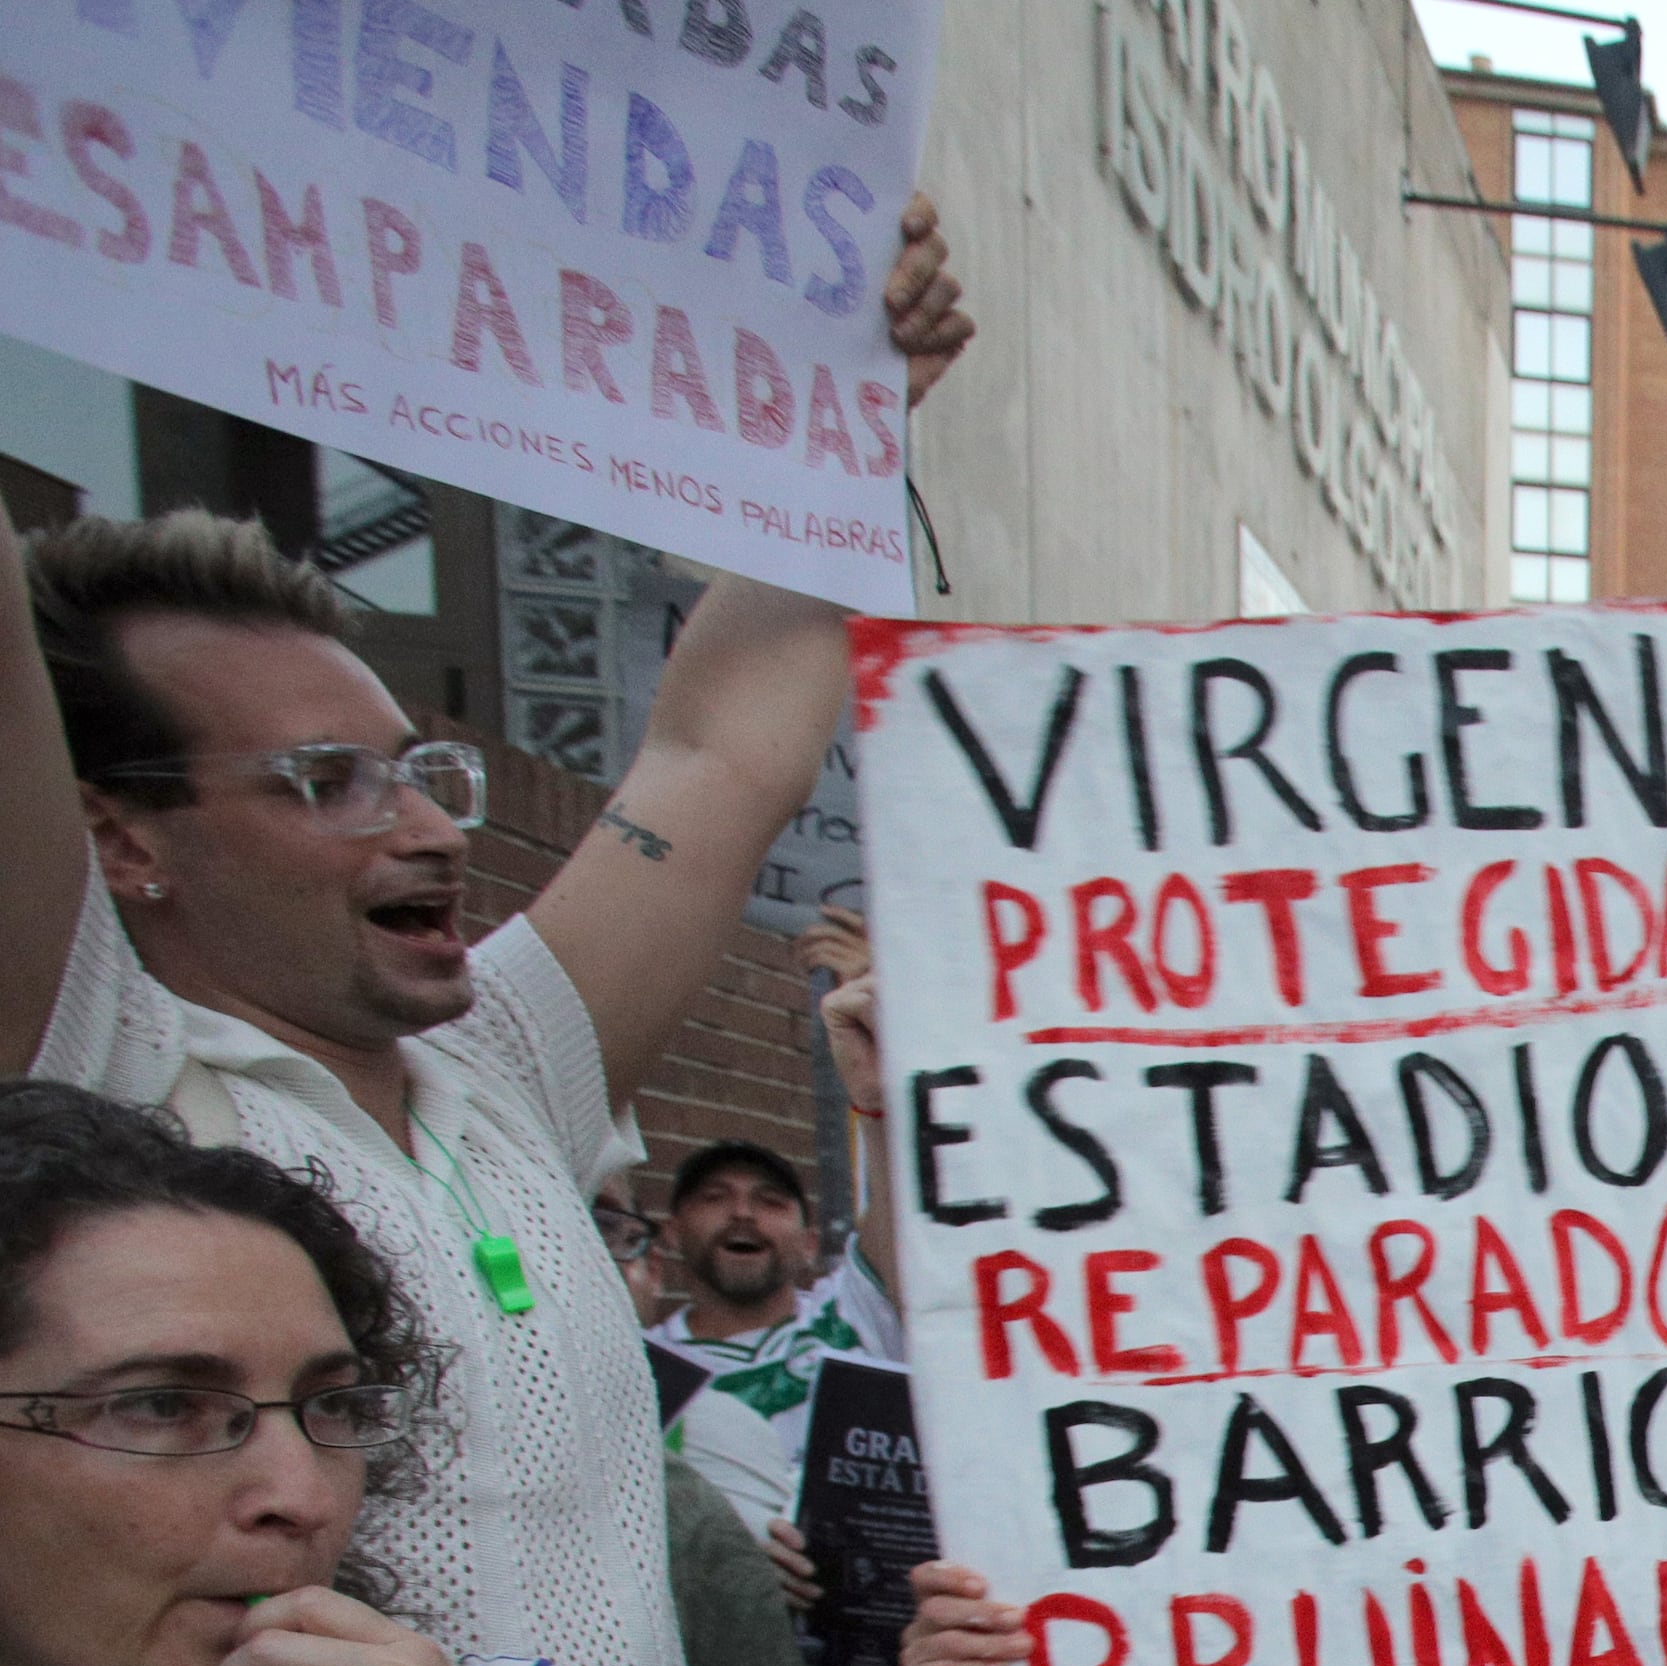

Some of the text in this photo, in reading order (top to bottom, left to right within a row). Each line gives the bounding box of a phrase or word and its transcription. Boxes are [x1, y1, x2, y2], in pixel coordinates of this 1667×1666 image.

[390, 392, 594, 472] ACCIONES
[608, 456, 723, 514] MENOS
[740, 500, 905, 564] PALABRAS
